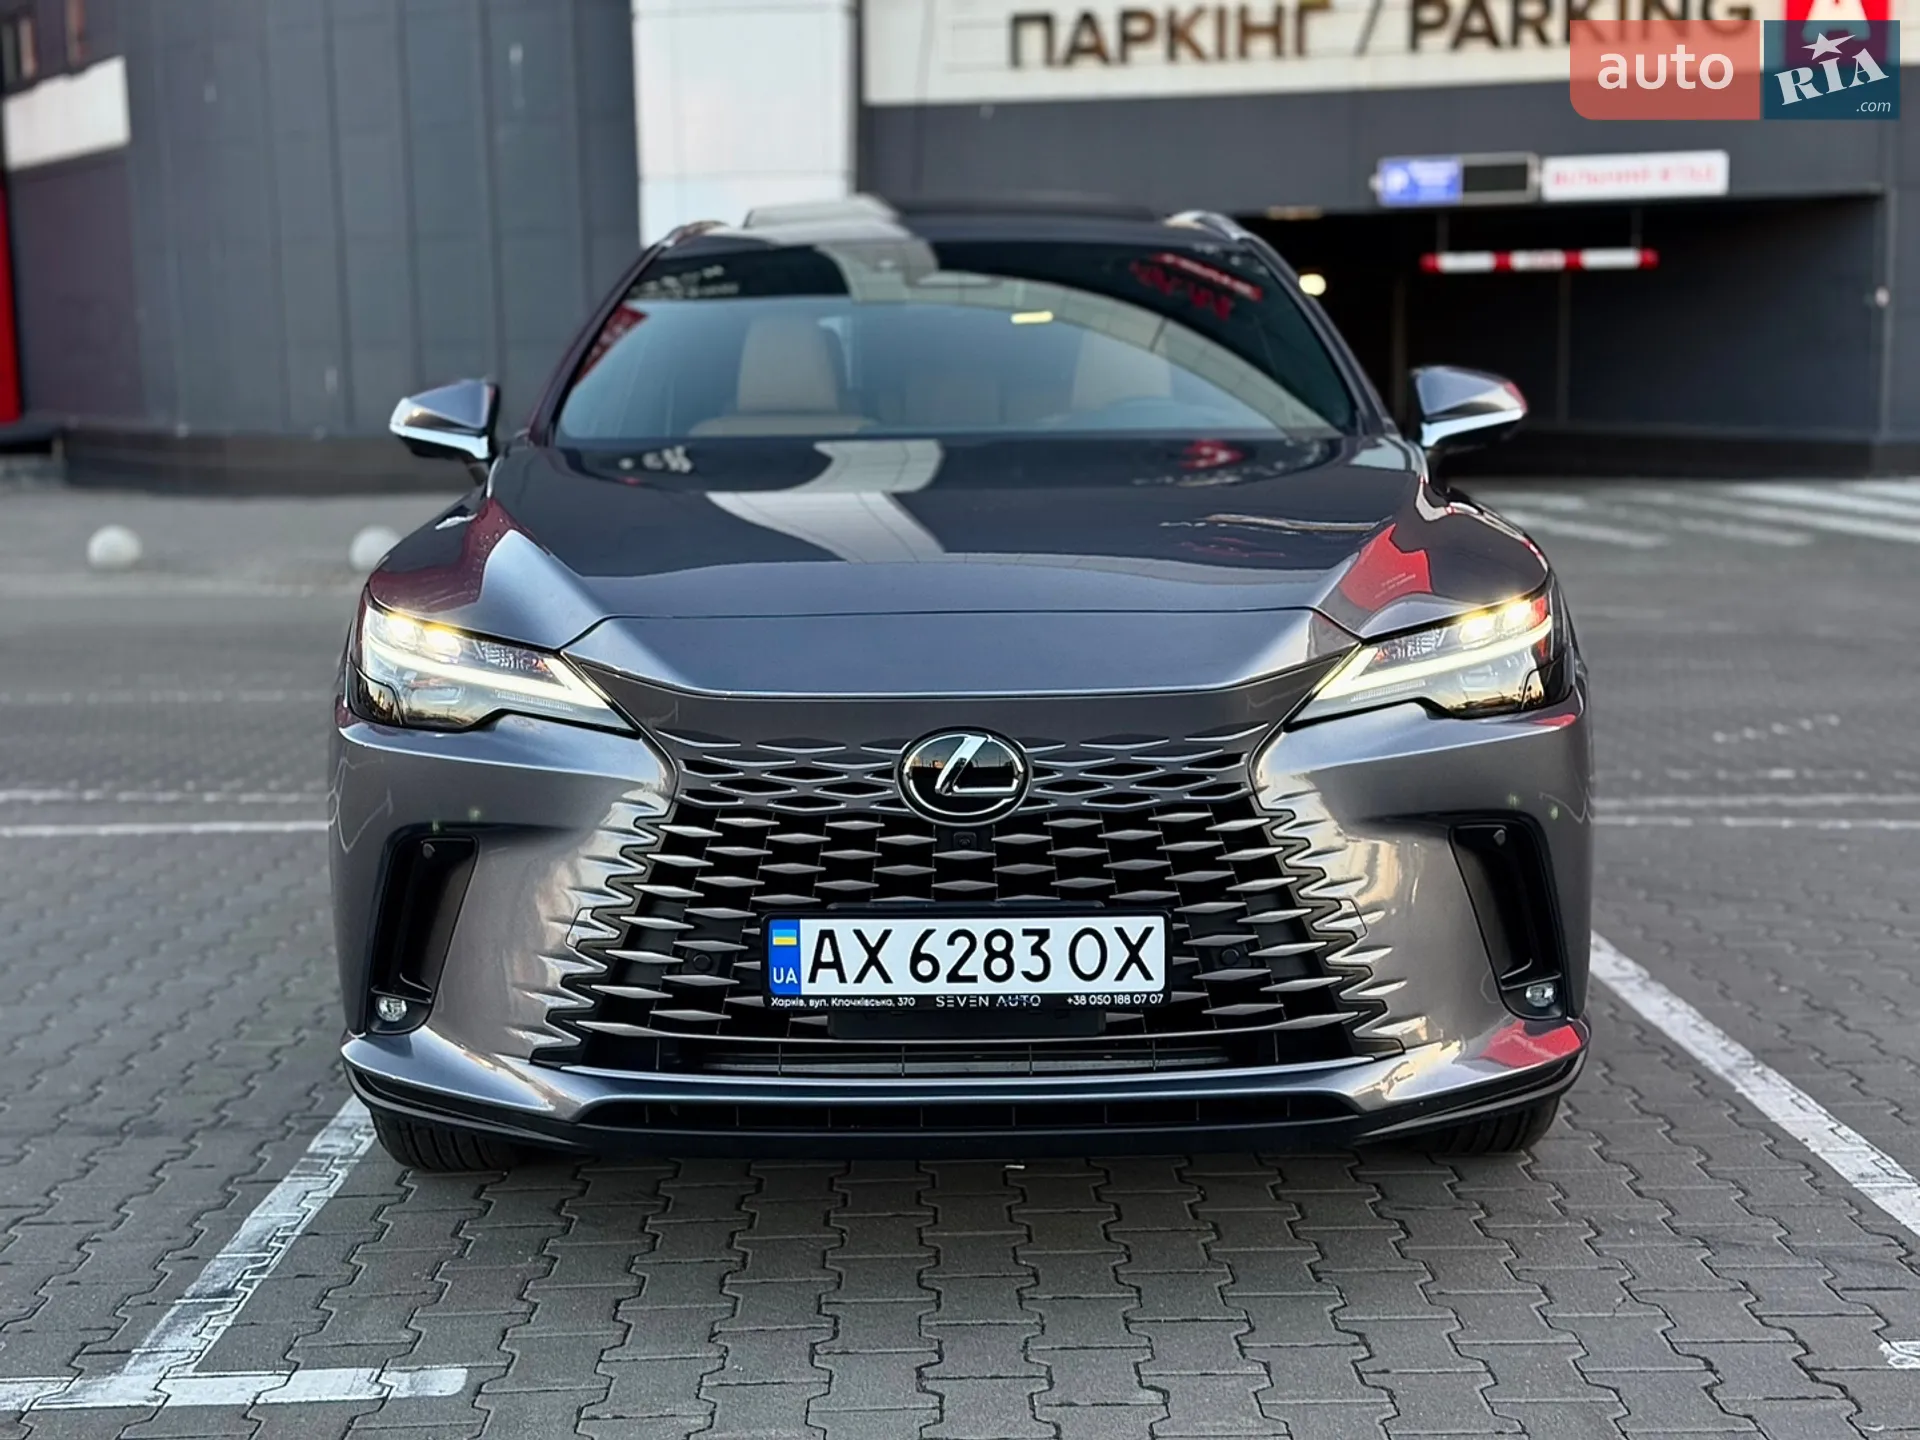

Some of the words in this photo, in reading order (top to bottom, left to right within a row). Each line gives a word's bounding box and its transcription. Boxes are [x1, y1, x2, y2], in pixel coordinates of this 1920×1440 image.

[1008, 0, 1335, 67] ПАРКІНГ
[1410, 0, 1755, 52] PARKING
[807, 928, 894, 984] AX
[909, 928, 1053, 984] 6283
[1068, 926, 1155, 983] OX
[772, 966, 798, 984] UA
[771, 997, 807, 1008] Харків,
[897, 996, 916, 1007] 370
[936, 995, 989, 1007] SEVEN
[995, 994, 1042, 1007] AUTO
[1067, 994, 1087, 1006] +38
[1088, 994, 1111, 1005] 050
[1113, 994, 1131, 1005] 188
[1133, 993, 1147, 1004] 07
[1149, 993, 1164, 1004] 07
